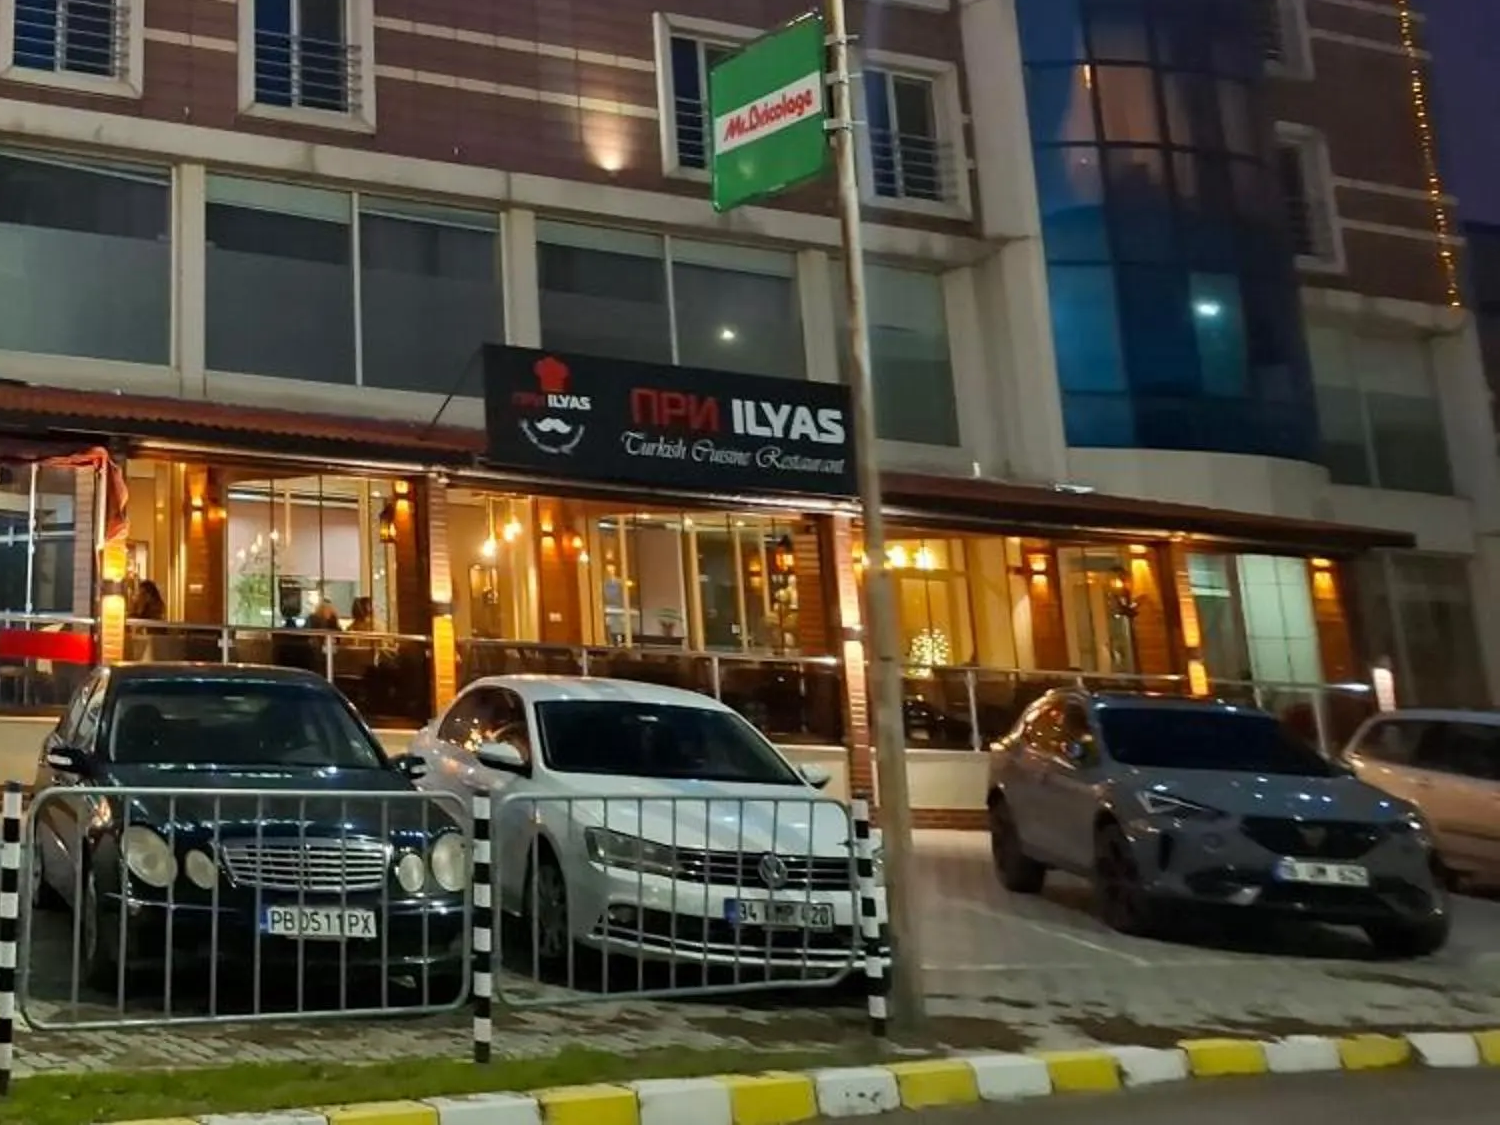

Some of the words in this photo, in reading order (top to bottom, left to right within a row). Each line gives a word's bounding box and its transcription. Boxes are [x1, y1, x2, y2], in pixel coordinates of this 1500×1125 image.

[547, 394, 592, 410] ILYAS
[630, 387, 721, 432] ПРИ
[731, 398, 845, 444] ILYAS
[621, 430, 686, 460] Turkish
[691, 438, 750, 467] Cuisine
[756, 445, 845, 474] Restaurant
